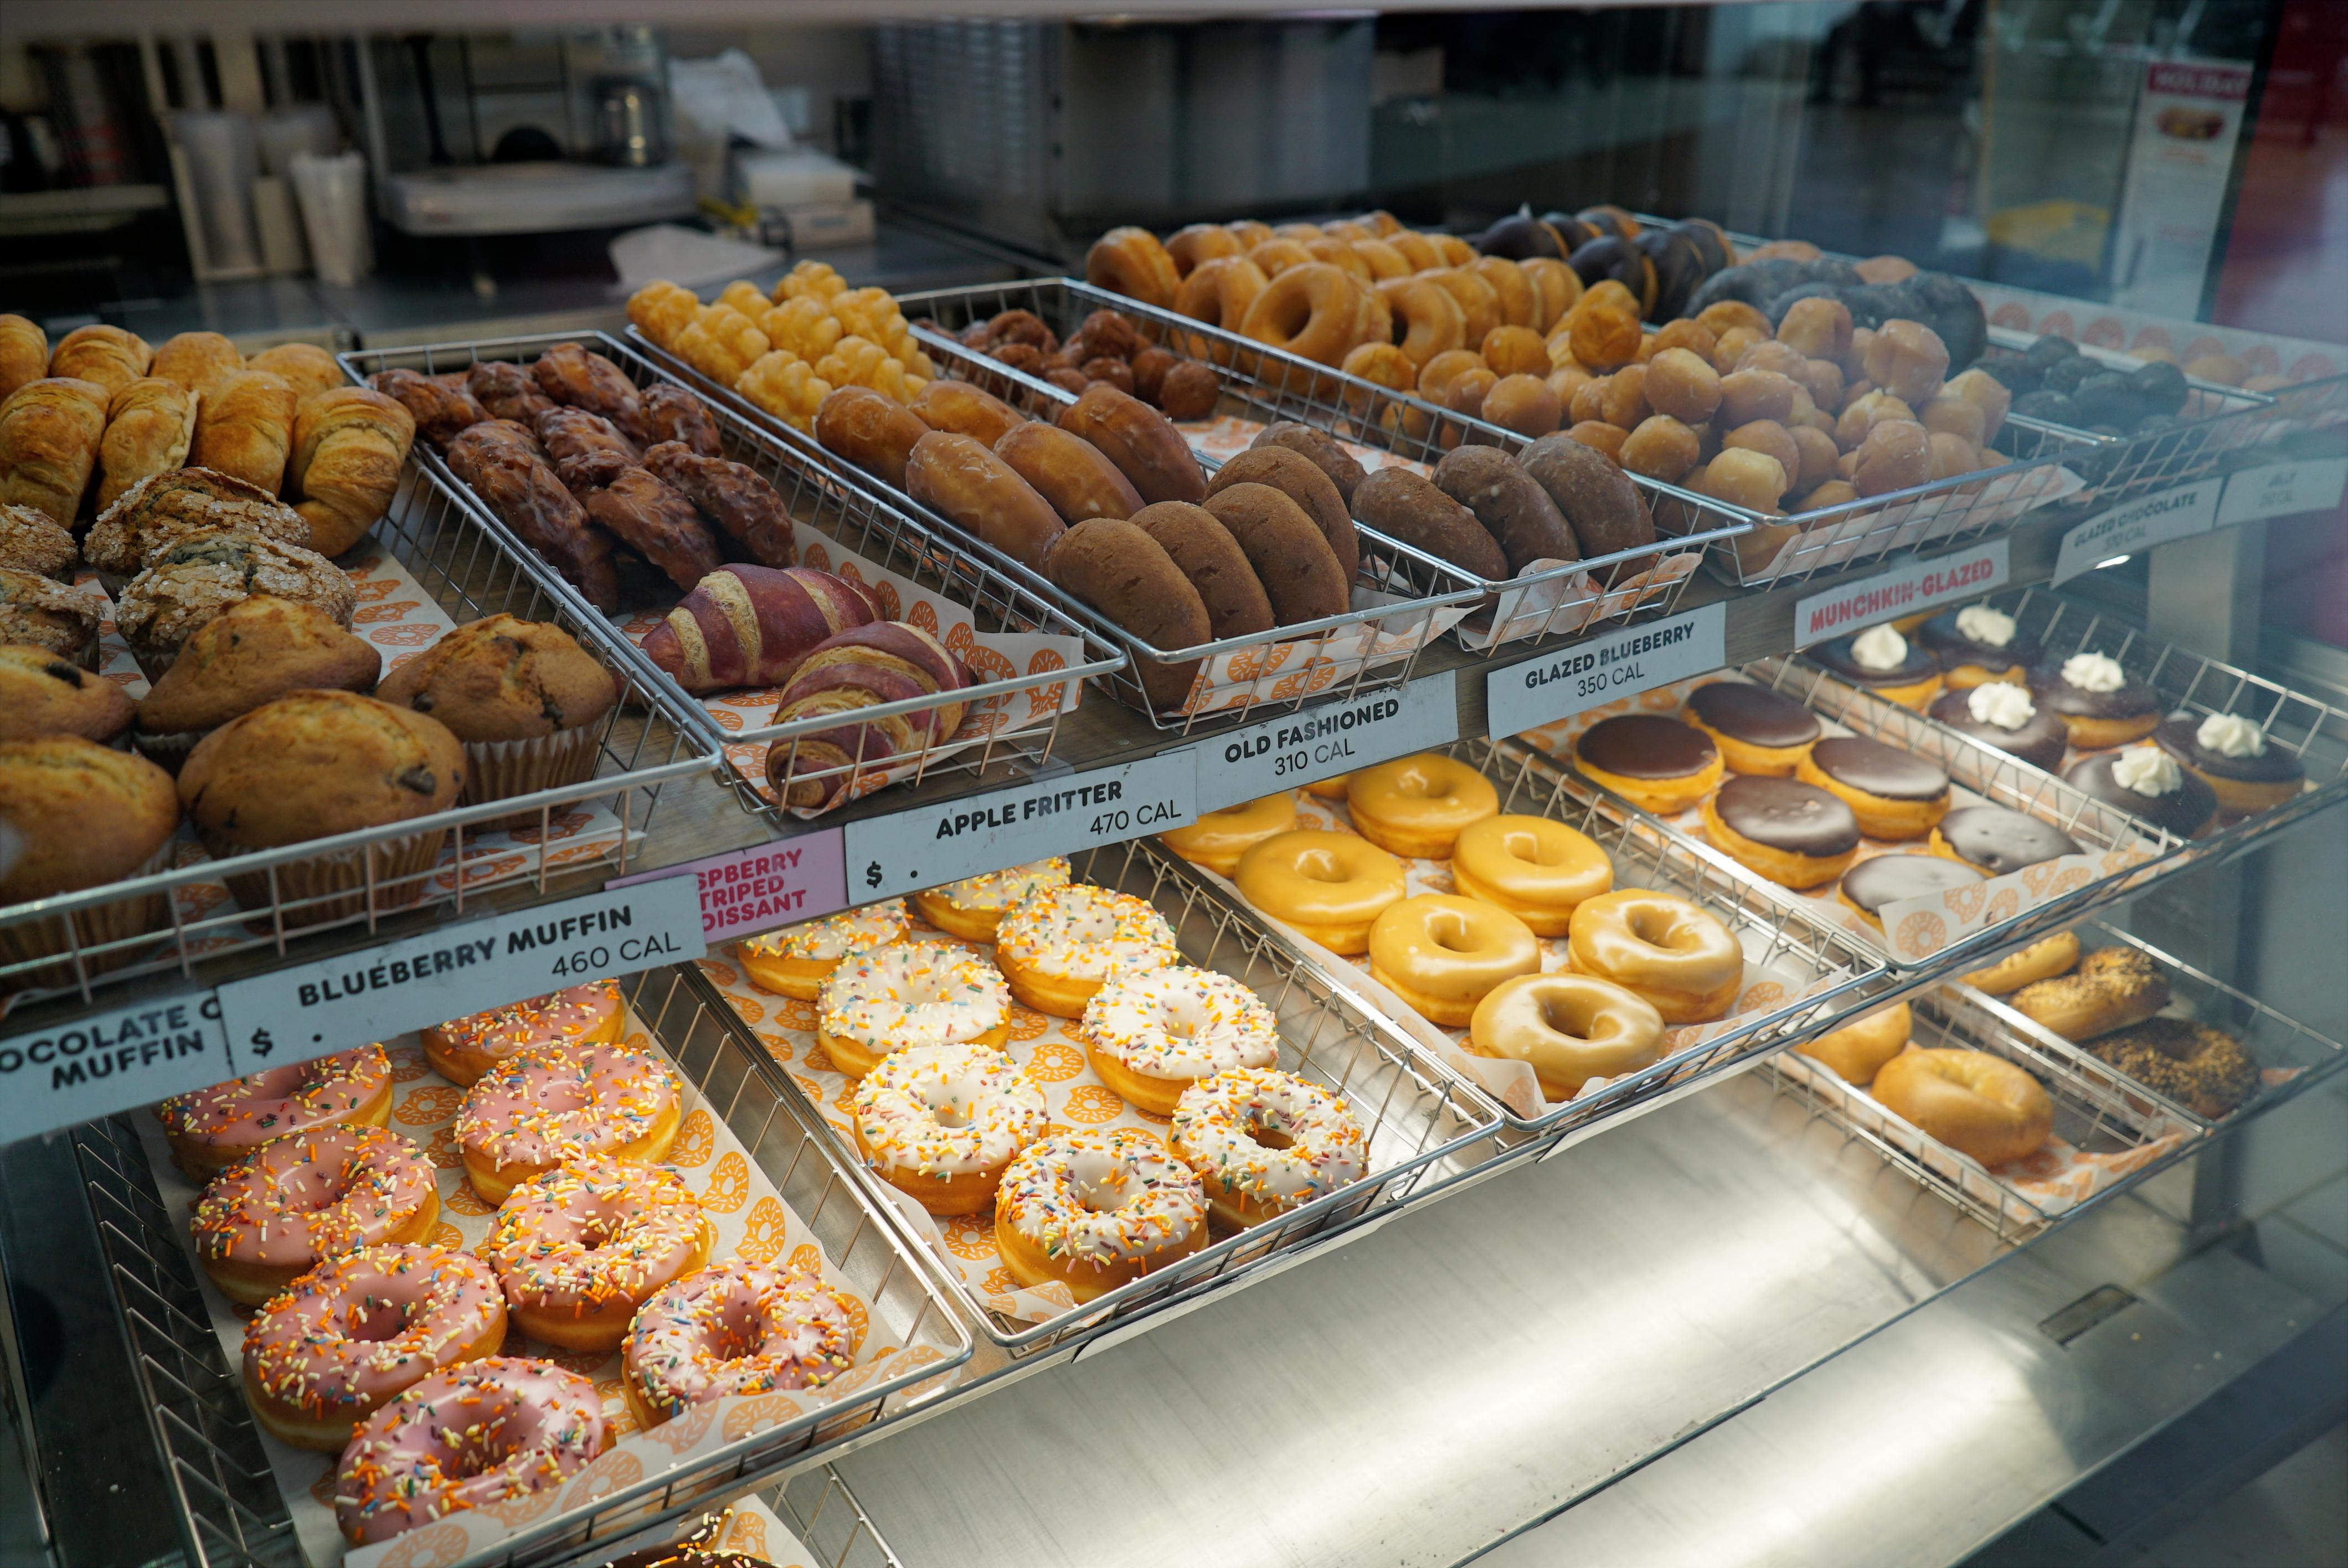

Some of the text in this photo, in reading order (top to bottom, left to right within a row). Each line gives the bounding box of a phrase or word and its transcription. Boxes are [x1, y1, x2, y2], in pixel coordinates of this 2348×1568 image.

[2074, 492, 2197, 548] GLAZED CHOCOLATE
[1809, 558, 1994, 634] MUNCHKIN-GLAZED
[1525, 622, 1695, 689] GLAZED BLUEBERRY
[1577, 662, 1645, 698] 350 CAL
[1225, 699, 1399, 763] OLD FASHIONED
[1274, 738, 1356, 776] 310 CAL
[936, 780, 1122, 840] APPLE FRITTER
[1090, 799, 1182, 835] 470 CAL
[698, 848, 802, 891] SPBERRY
[700, 875, 785, 911] TRIPED
[866, 861, 883, 889] $
[297, 905, 633, 1008] BLUEBERRY MUFFIN
[552, 932, 682, 978] 460 CAL
[0, 1004, 189, 1073] OCOLATE
[52, 1029, 205, 1091] MUFFIN
[251, 1027, 274, 1058] $
